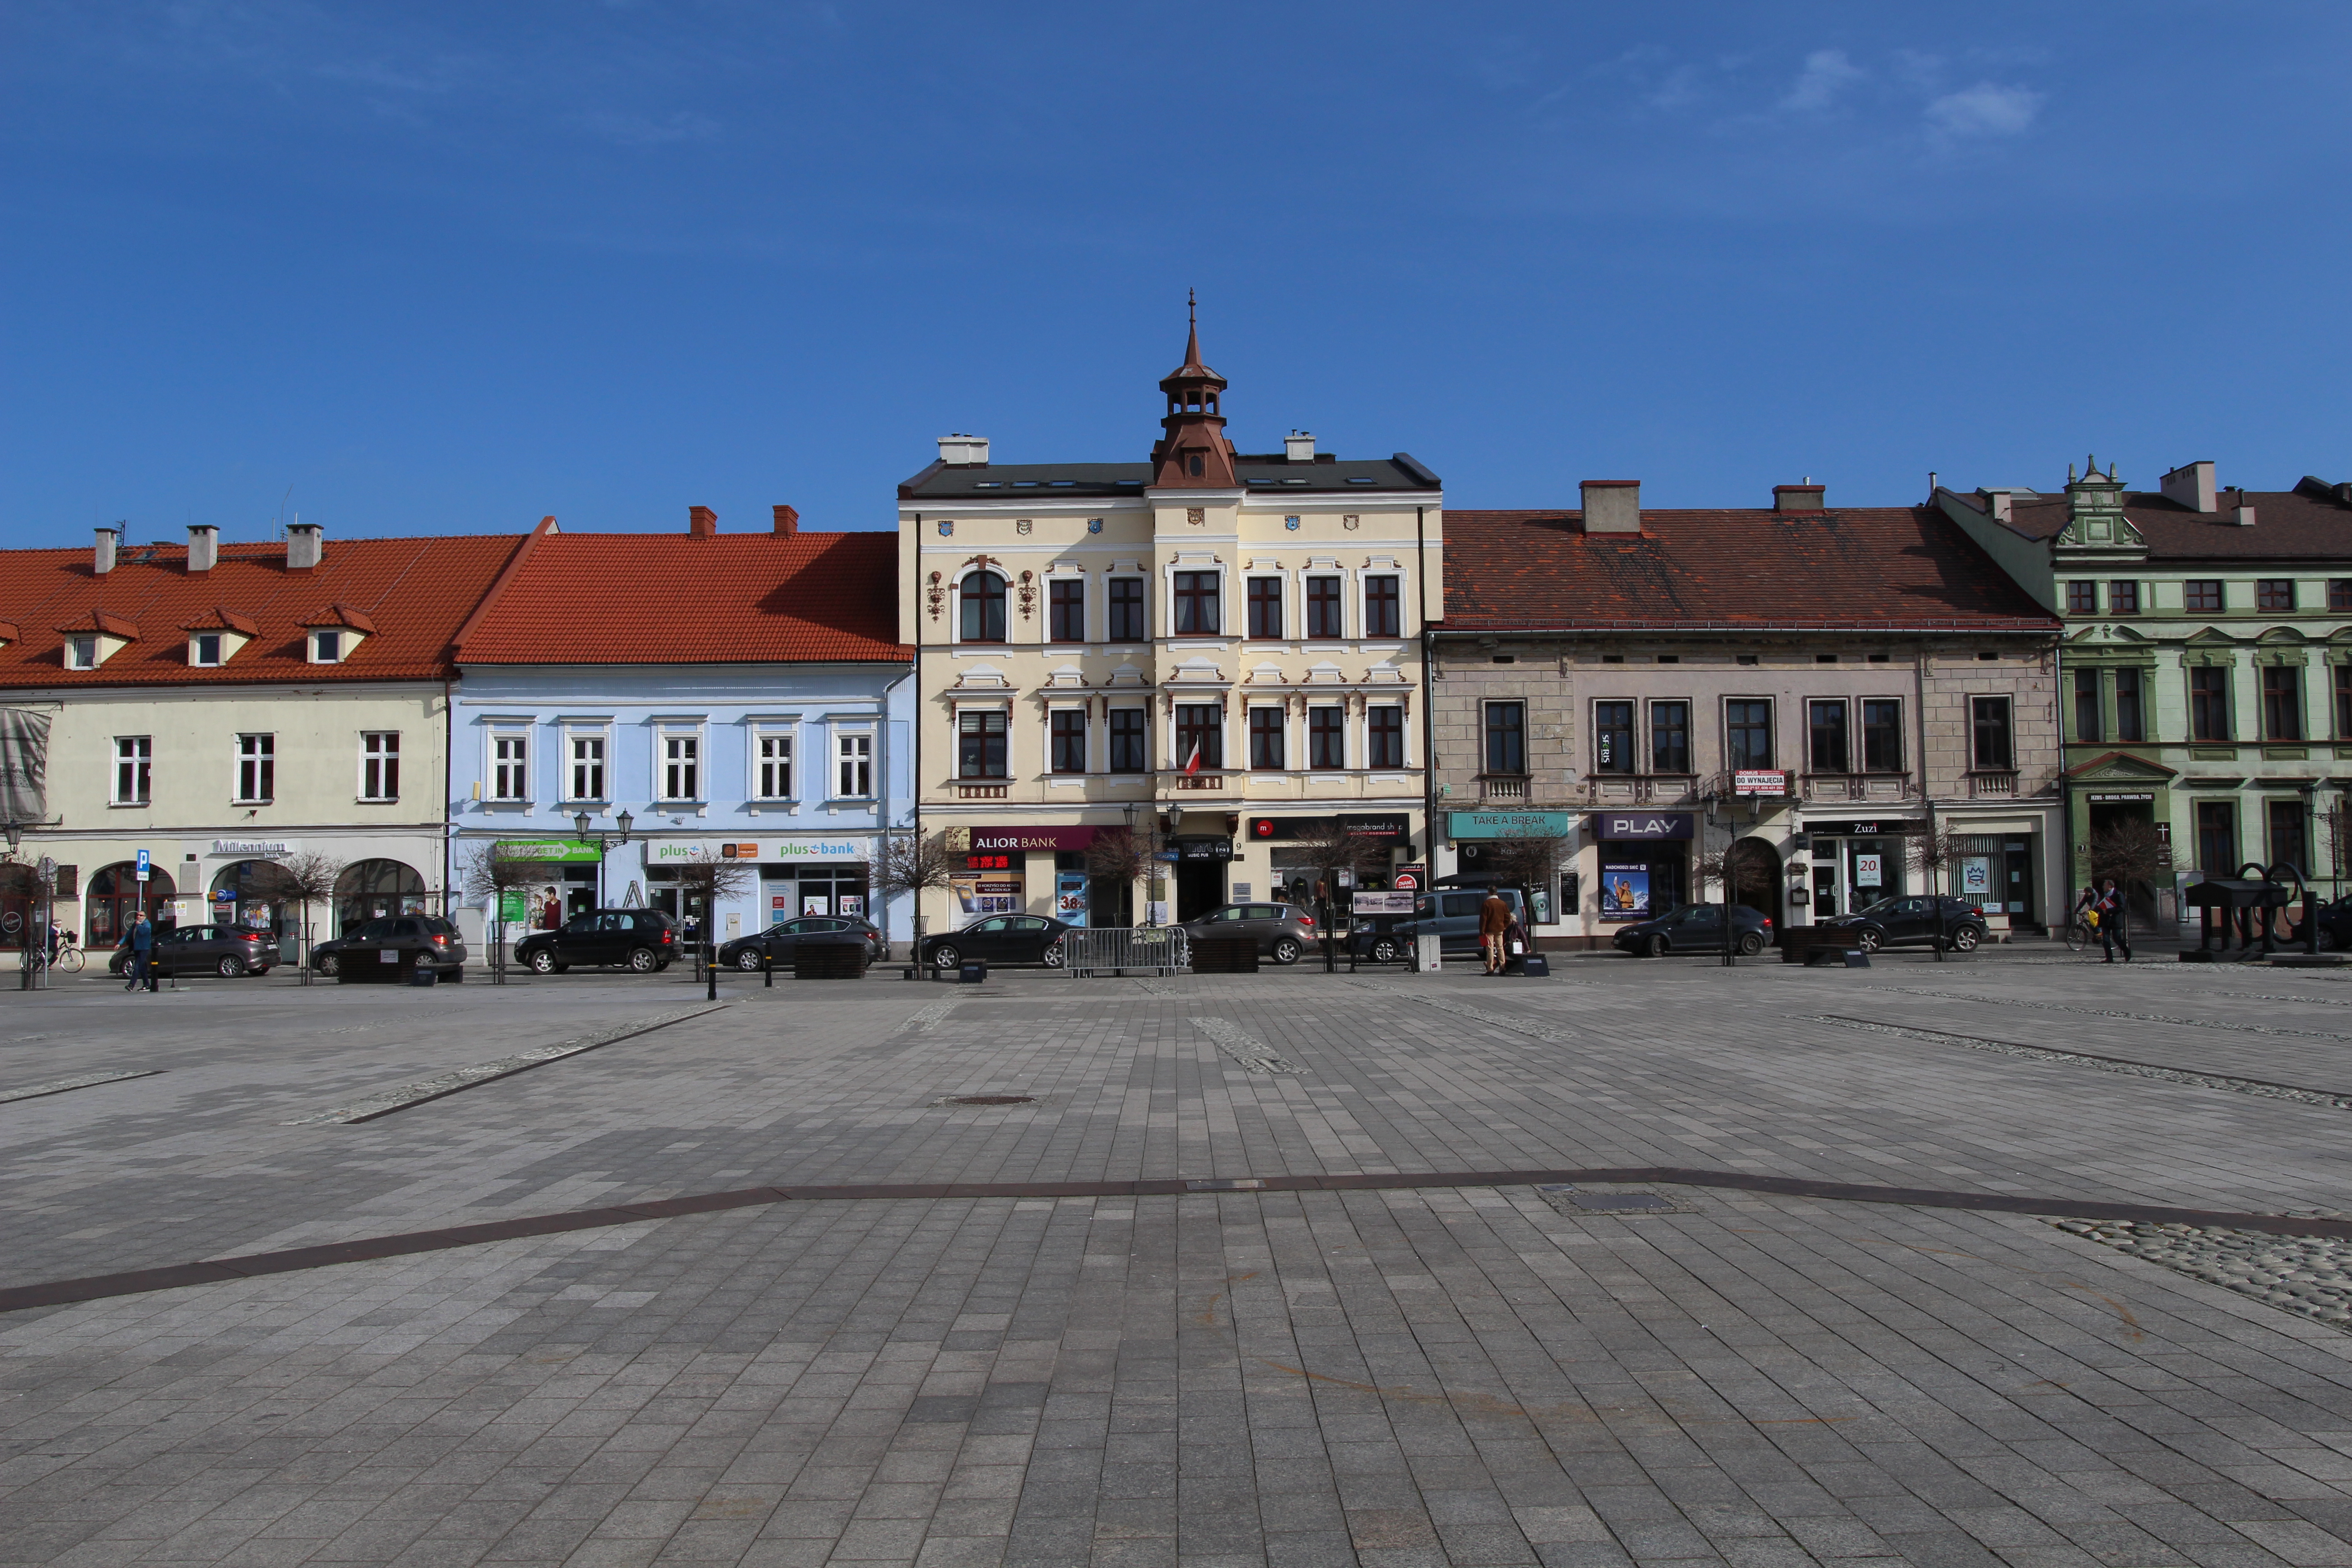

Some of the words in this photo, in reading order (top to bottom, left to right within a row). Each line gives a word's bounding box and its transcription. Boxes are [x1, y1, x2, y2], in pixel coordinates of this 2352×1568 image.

[1473, 816, 1498, 825] TAKE
[1501, 816, 1508, 824] A
[1511, 816, 1545, 824] BREAK
[1614, 819, 1678, 833] PLAY
[1347, 823, 1385, 832] megabrand
[1854, 823, 1877, 833] Zuzi
[216, 839, 287, 852] Millennium
[976, 838, 1018, 848] ALIOR
[1021, 838, 1057, 848] BANK
[660, 844, 688, 858] plus
[781, 843, 808, 858] plus
[821, 842, 854, 854] bank
[140, 852, 147, 869] P
[1060, 896, 1085, 910] 3,8%
